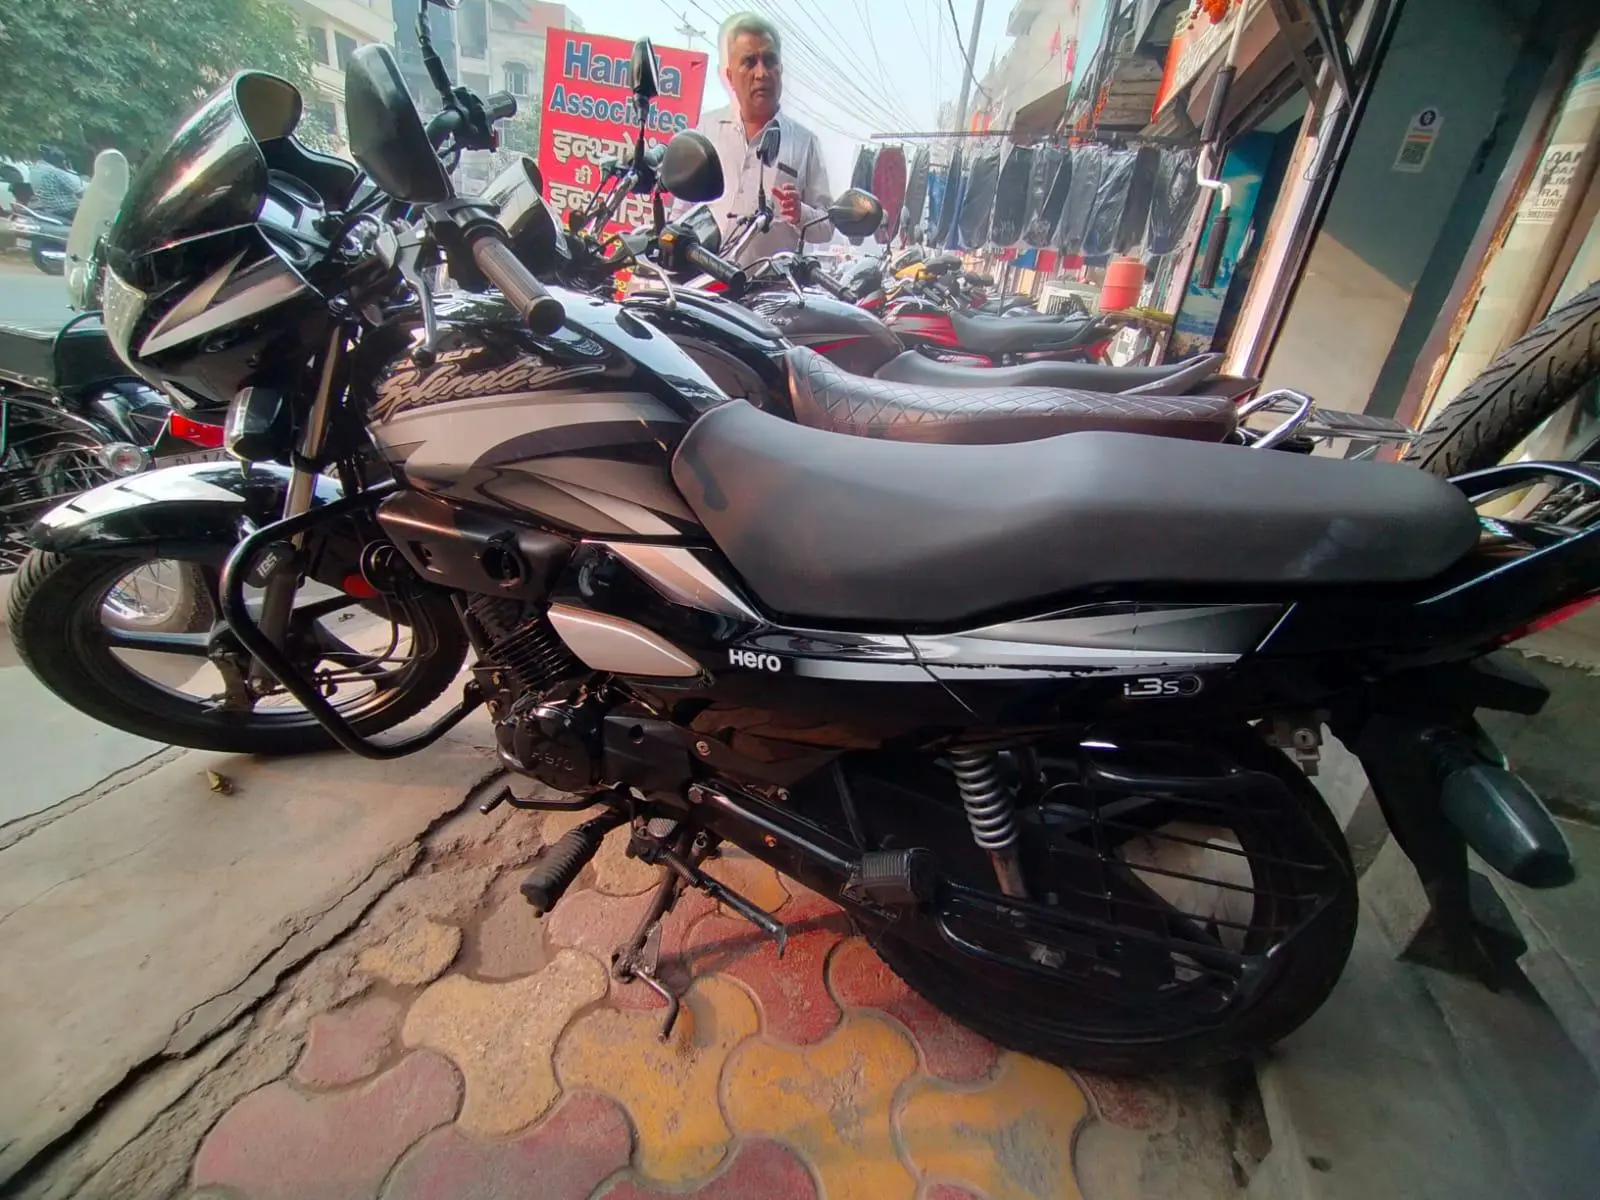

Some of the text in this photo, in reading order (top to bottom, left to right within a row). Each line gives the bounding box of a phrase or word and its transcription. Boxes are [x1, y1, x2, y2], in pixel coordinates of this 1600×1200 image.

[563, 39, 682, 98] Hana
[367, 352, 606, 424] Splendor
[729, 648, 782, 672] Hero
